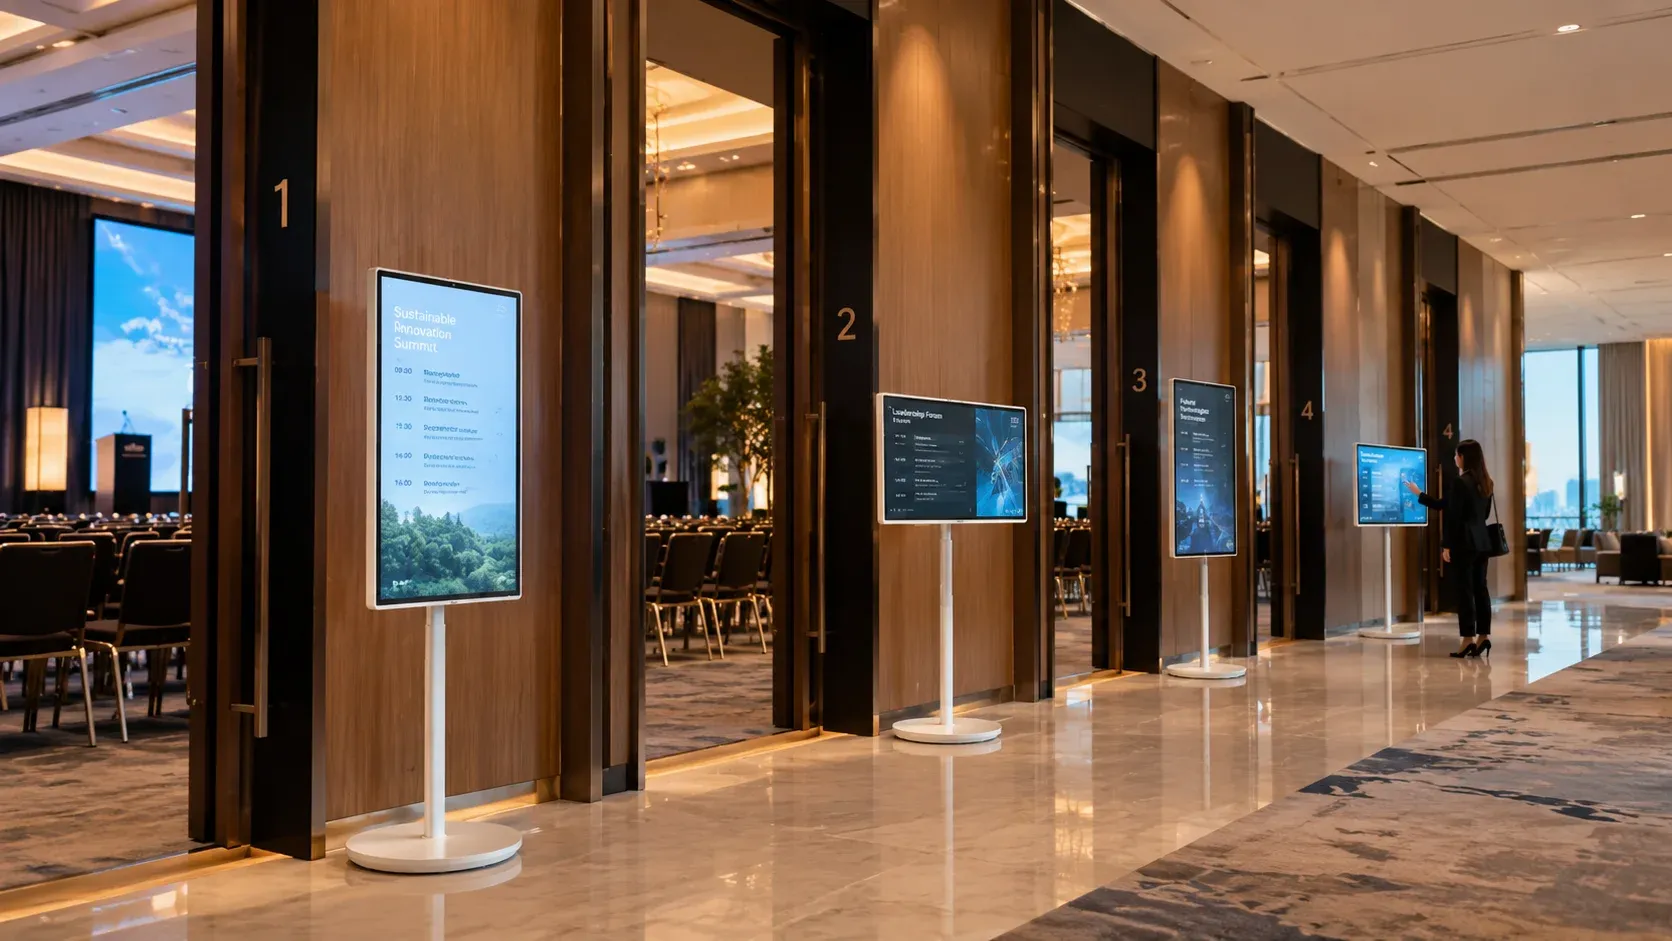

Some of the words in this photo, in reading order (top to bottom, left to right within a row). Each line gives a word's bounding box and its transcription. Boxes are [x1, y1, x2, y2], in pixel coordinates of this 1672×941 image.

[274, 179, 288, 228] 1
[394, 305, 457, 326] Sustainable
[837, 307, 856, 341] 2
[1132, 368, 1147, 393] 3
[1301, 400, 1314, 421] 4
[1443, 423, 1454, 440] 4
